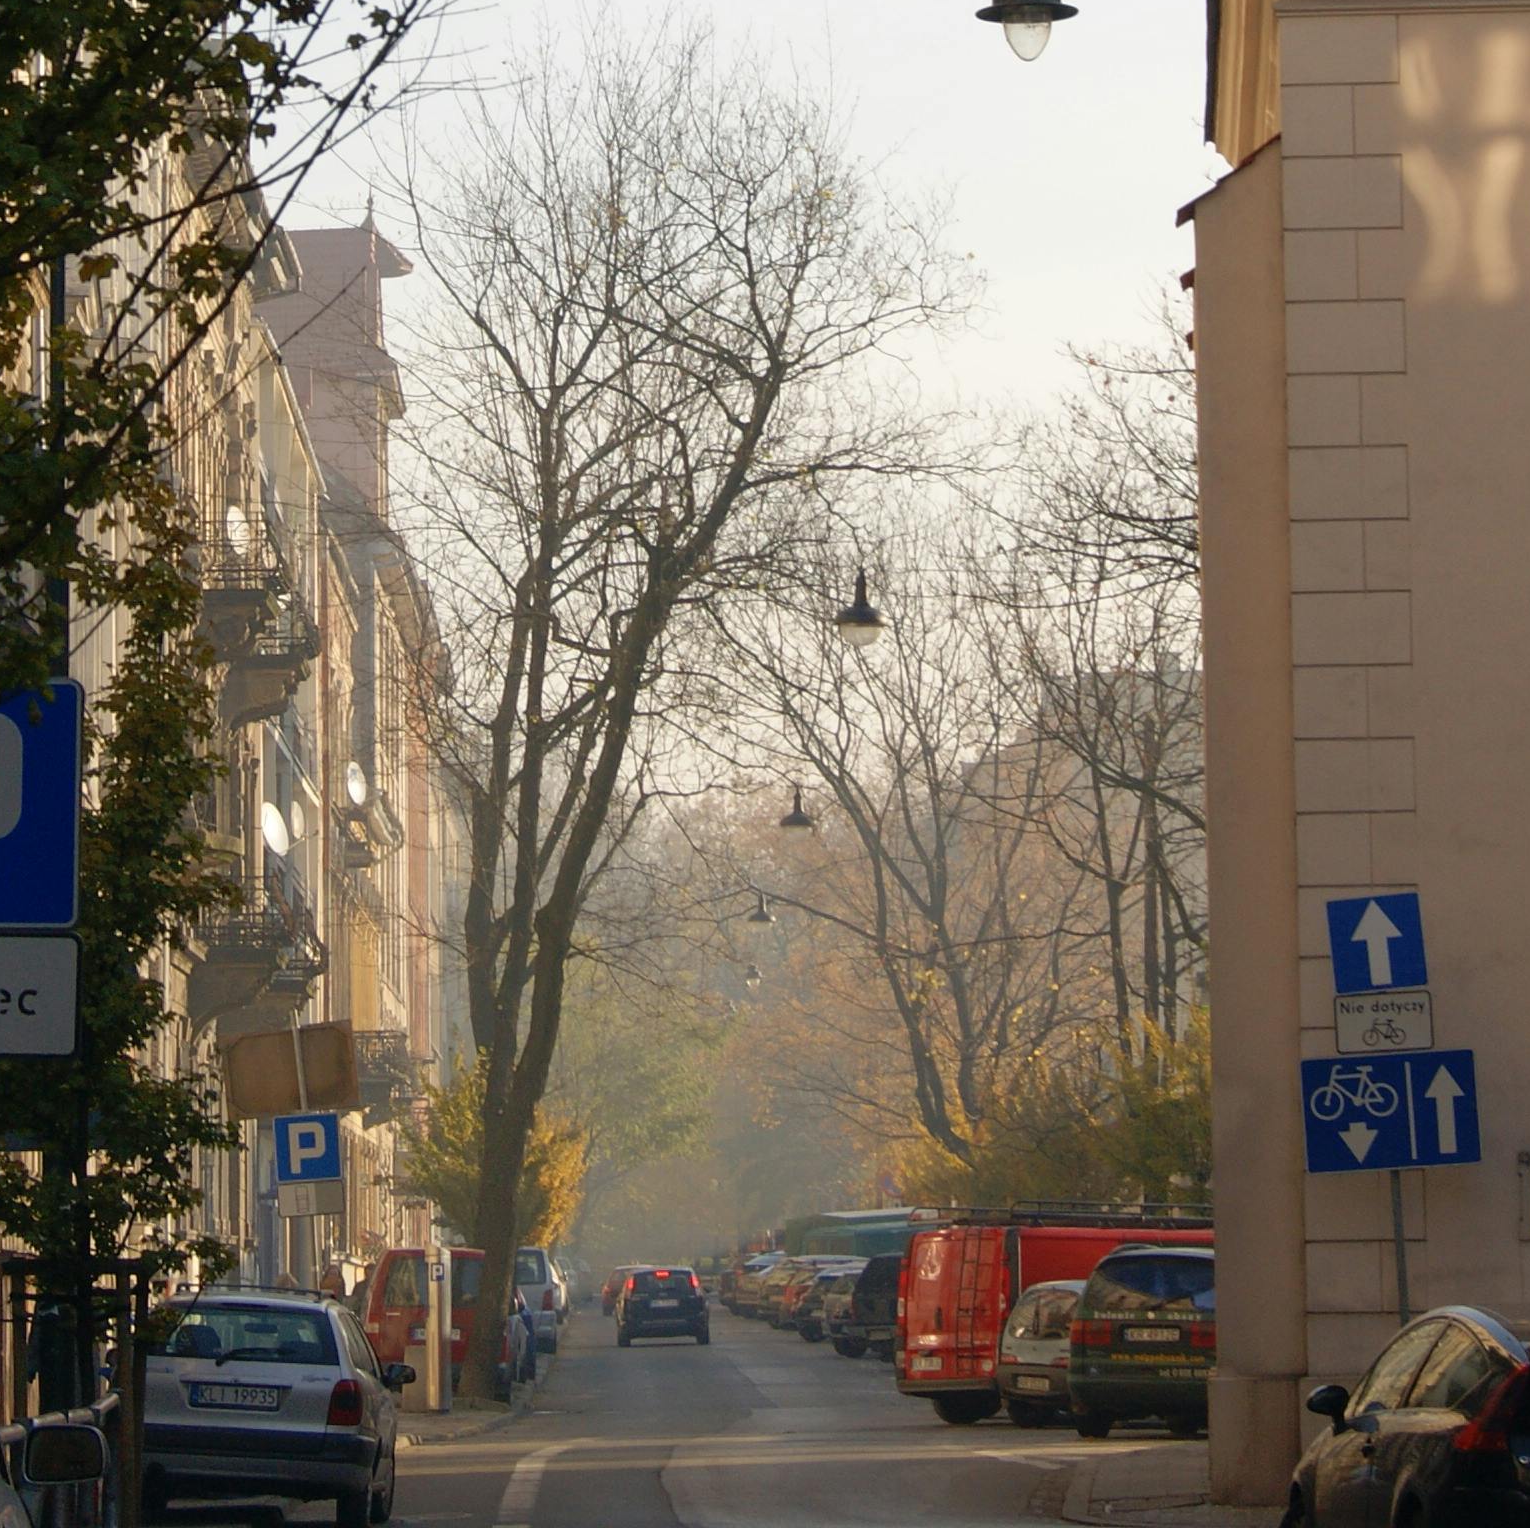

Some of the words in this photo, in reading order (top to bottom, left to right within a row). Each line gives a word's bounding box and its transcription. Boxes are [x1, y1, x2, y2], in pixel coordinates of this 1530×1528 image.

[1339, 1000, 1364, 1015] Nie
[1370, 998, 1426, 1015] dotyczy
[287, 1122, 325, 1174] P
[432, 1264, 443, 1281] P
